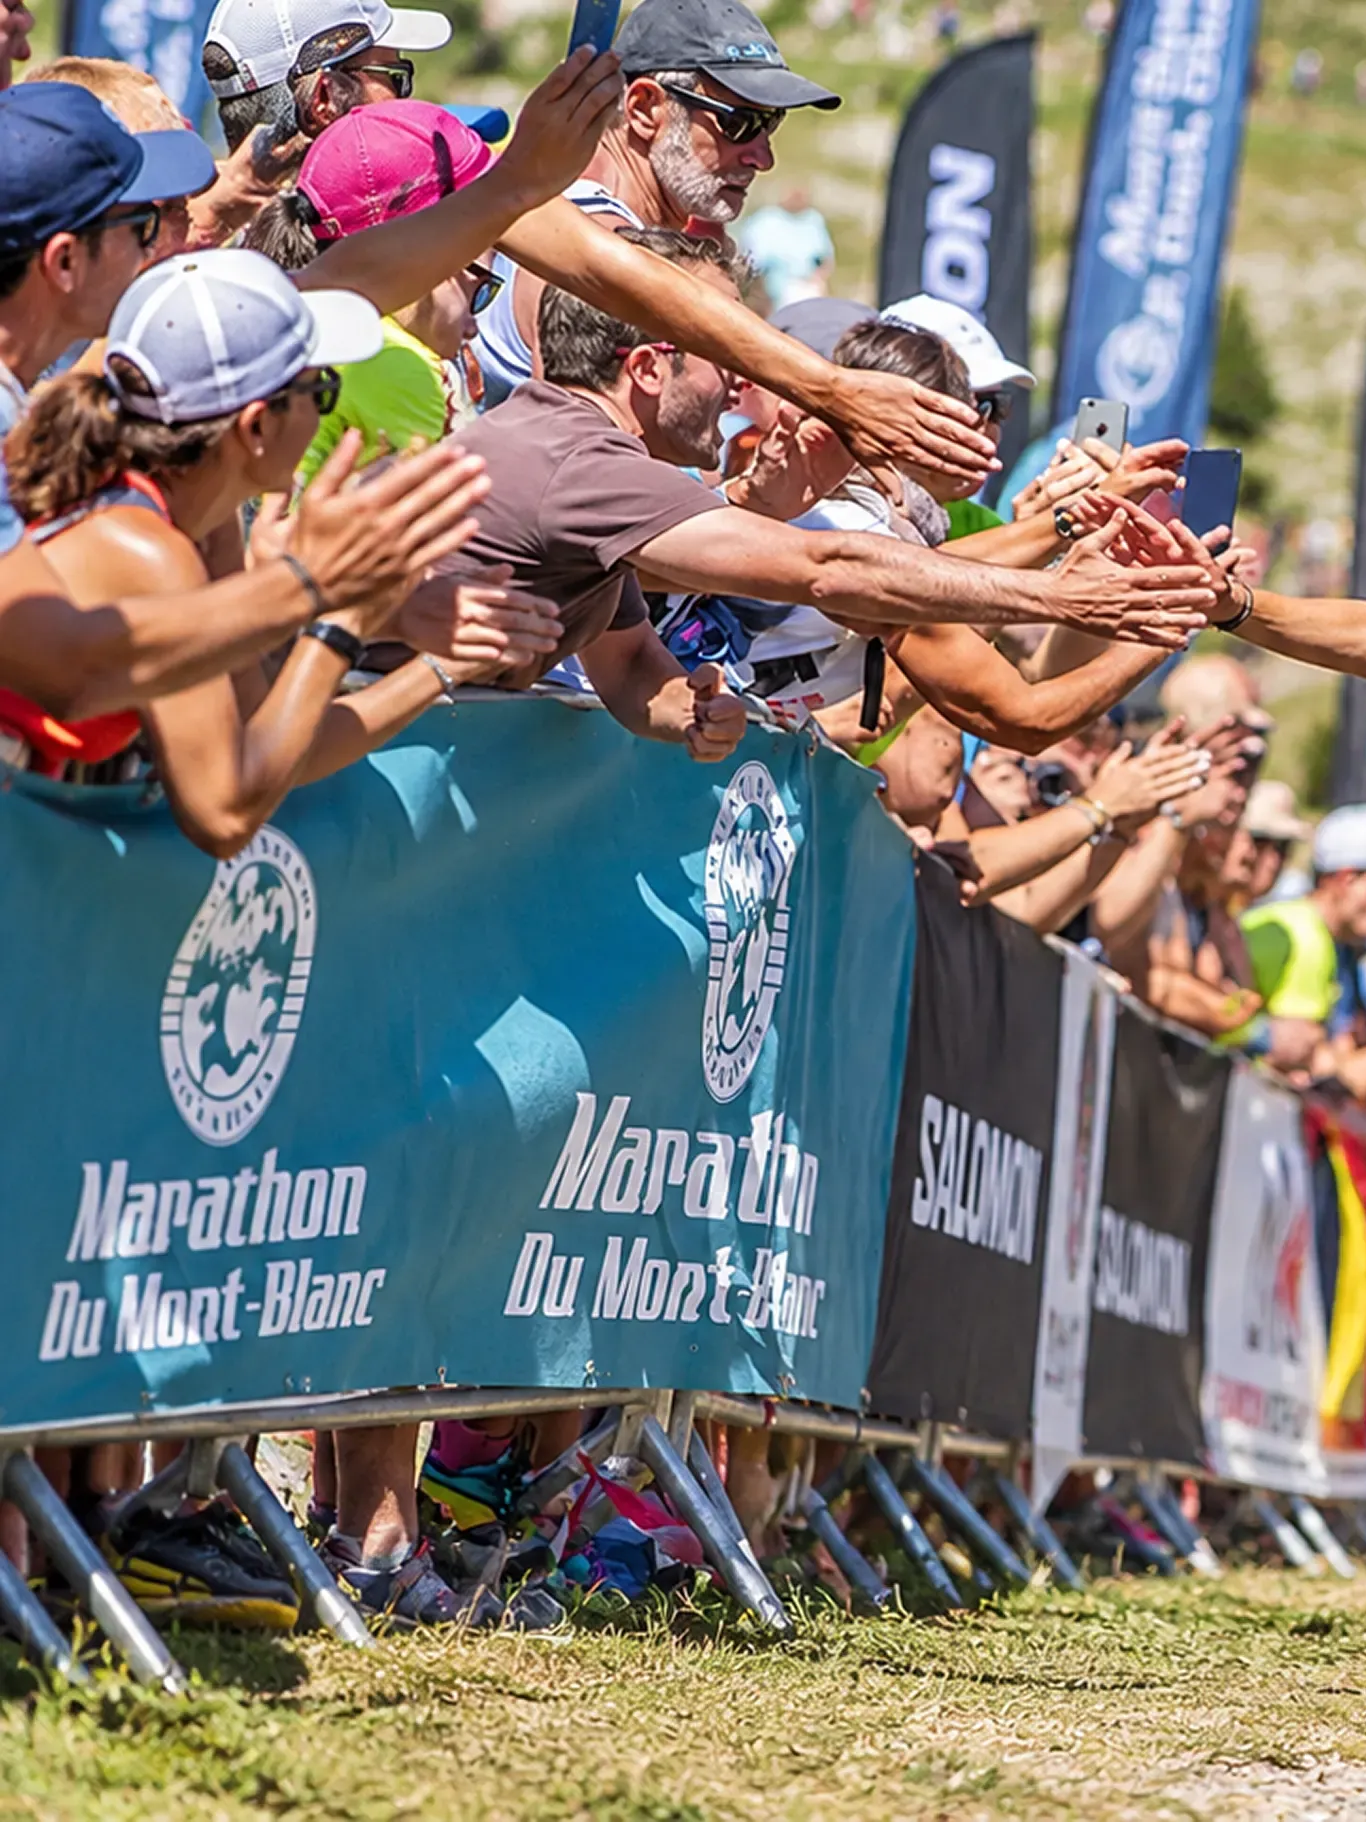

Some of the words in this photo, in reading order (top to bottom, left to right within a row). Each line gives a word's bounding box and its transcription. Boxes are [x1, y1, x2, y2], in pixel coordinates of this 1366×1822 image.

[922, 143, 996, 322] ON
[66, 1147, 367, 1262] Marathon
[911, 1093, 1043, 1266] SALOMON
[39, 1280, 106, 1361] Du
[114, 1258, 386, 1353] Mont-Blanc
[504, 1232, 584, 1316] Du
